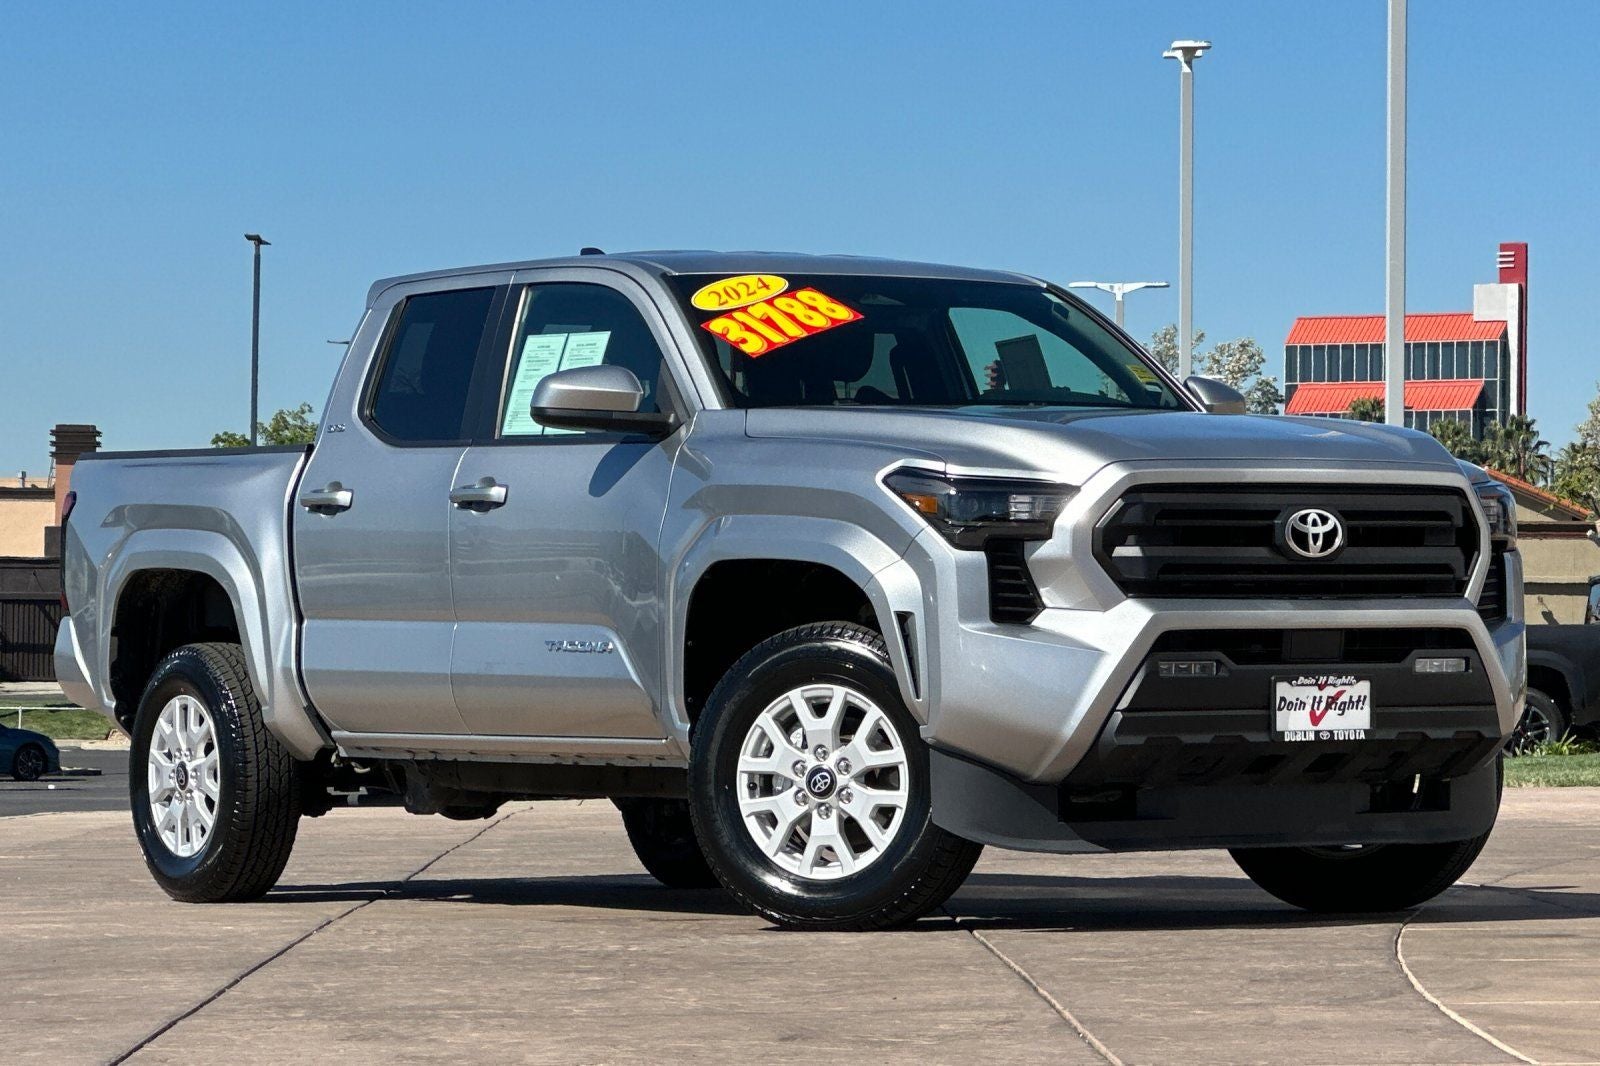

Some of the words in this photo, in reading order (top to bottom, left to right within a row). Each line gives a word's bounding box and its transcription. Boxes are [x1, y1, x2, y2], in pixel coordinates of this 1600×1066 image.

[708, 277, 771, 307] 2024
[709, 290, 854, 354] 31788
[1277, 695, 1309, 711] Doin'
[1310, 695, 1323, 711] It
[1325, 695, 1367, 716] Right!
[1284, 731, 1315, 741] DUBLIN
[1333, 730, 1366, 740] TOYOTA
